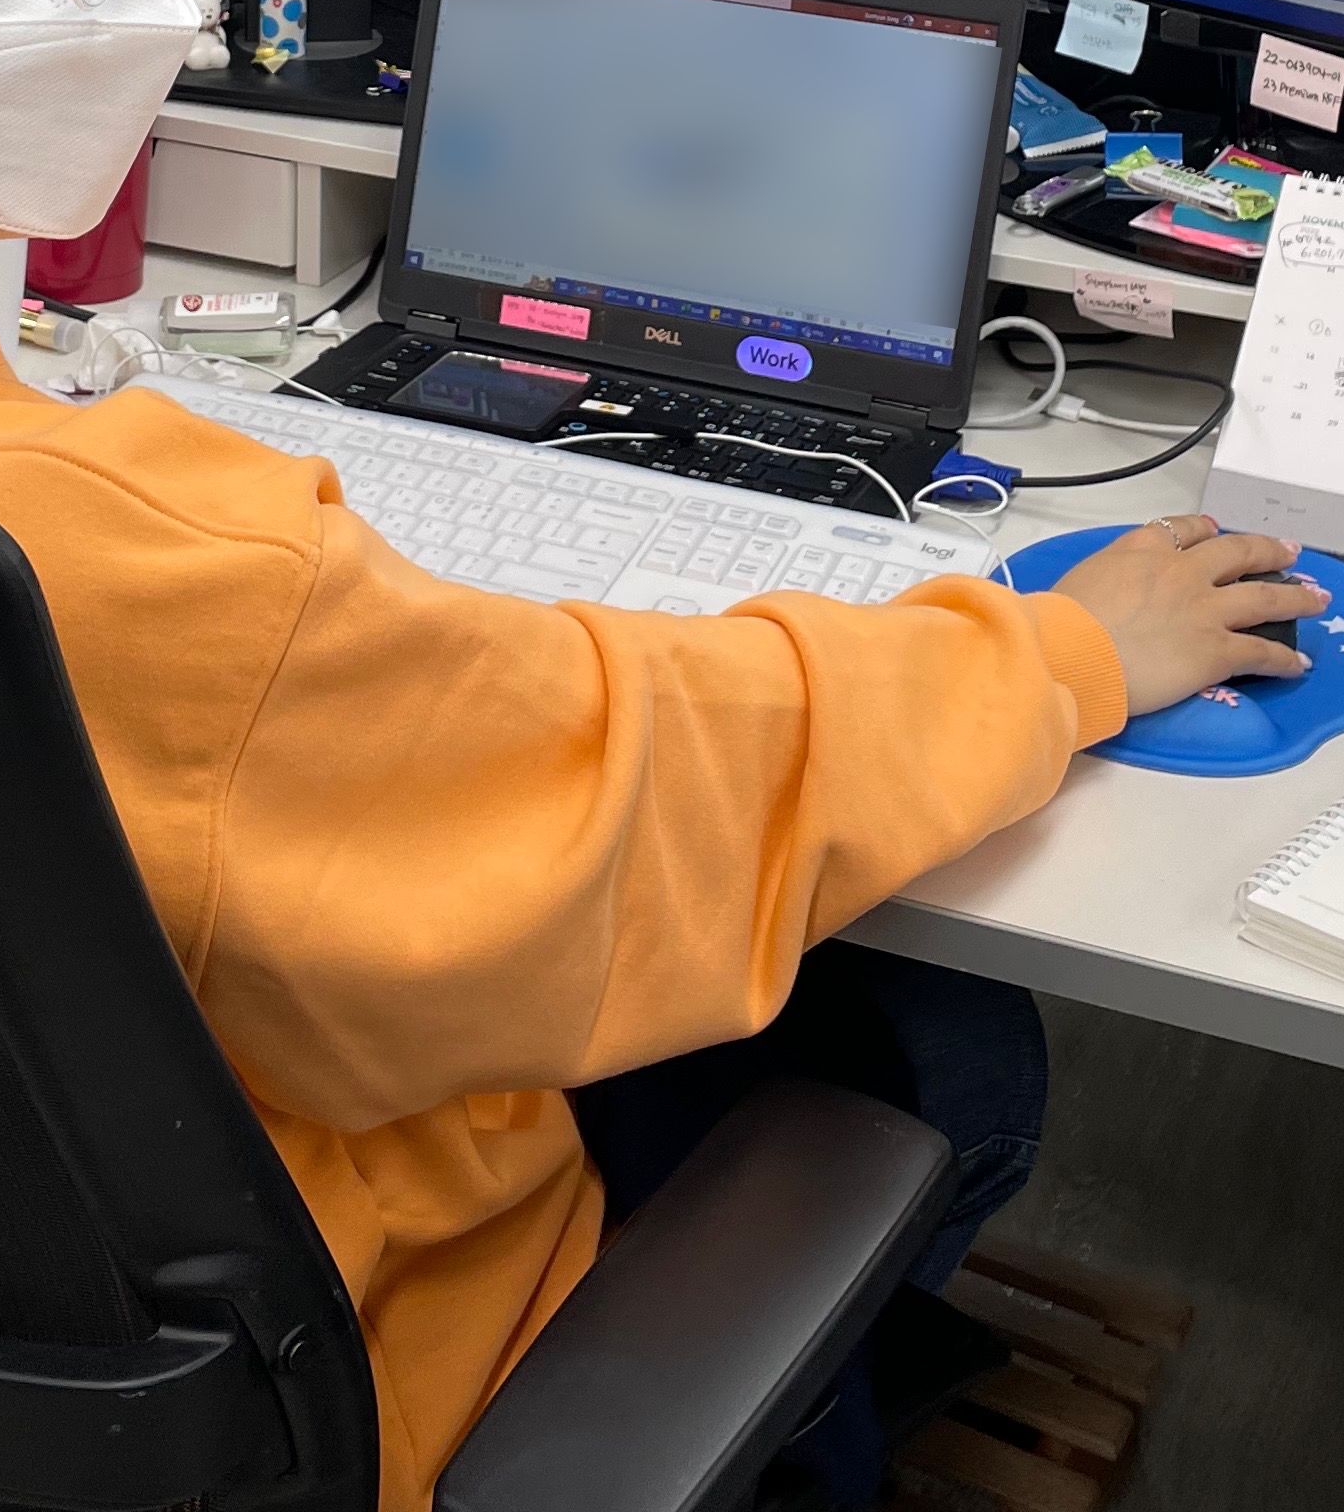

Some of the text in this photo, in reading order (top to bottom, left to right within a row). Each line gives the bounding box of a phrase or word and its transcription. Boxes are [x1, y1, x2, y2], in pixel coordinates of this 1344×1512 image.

[1263, 77, 1277, 92] 23
[643, 325, 683, 346] DELL
[749, 346, 799, 371] Work
[920, 542, 957, 560] logi
